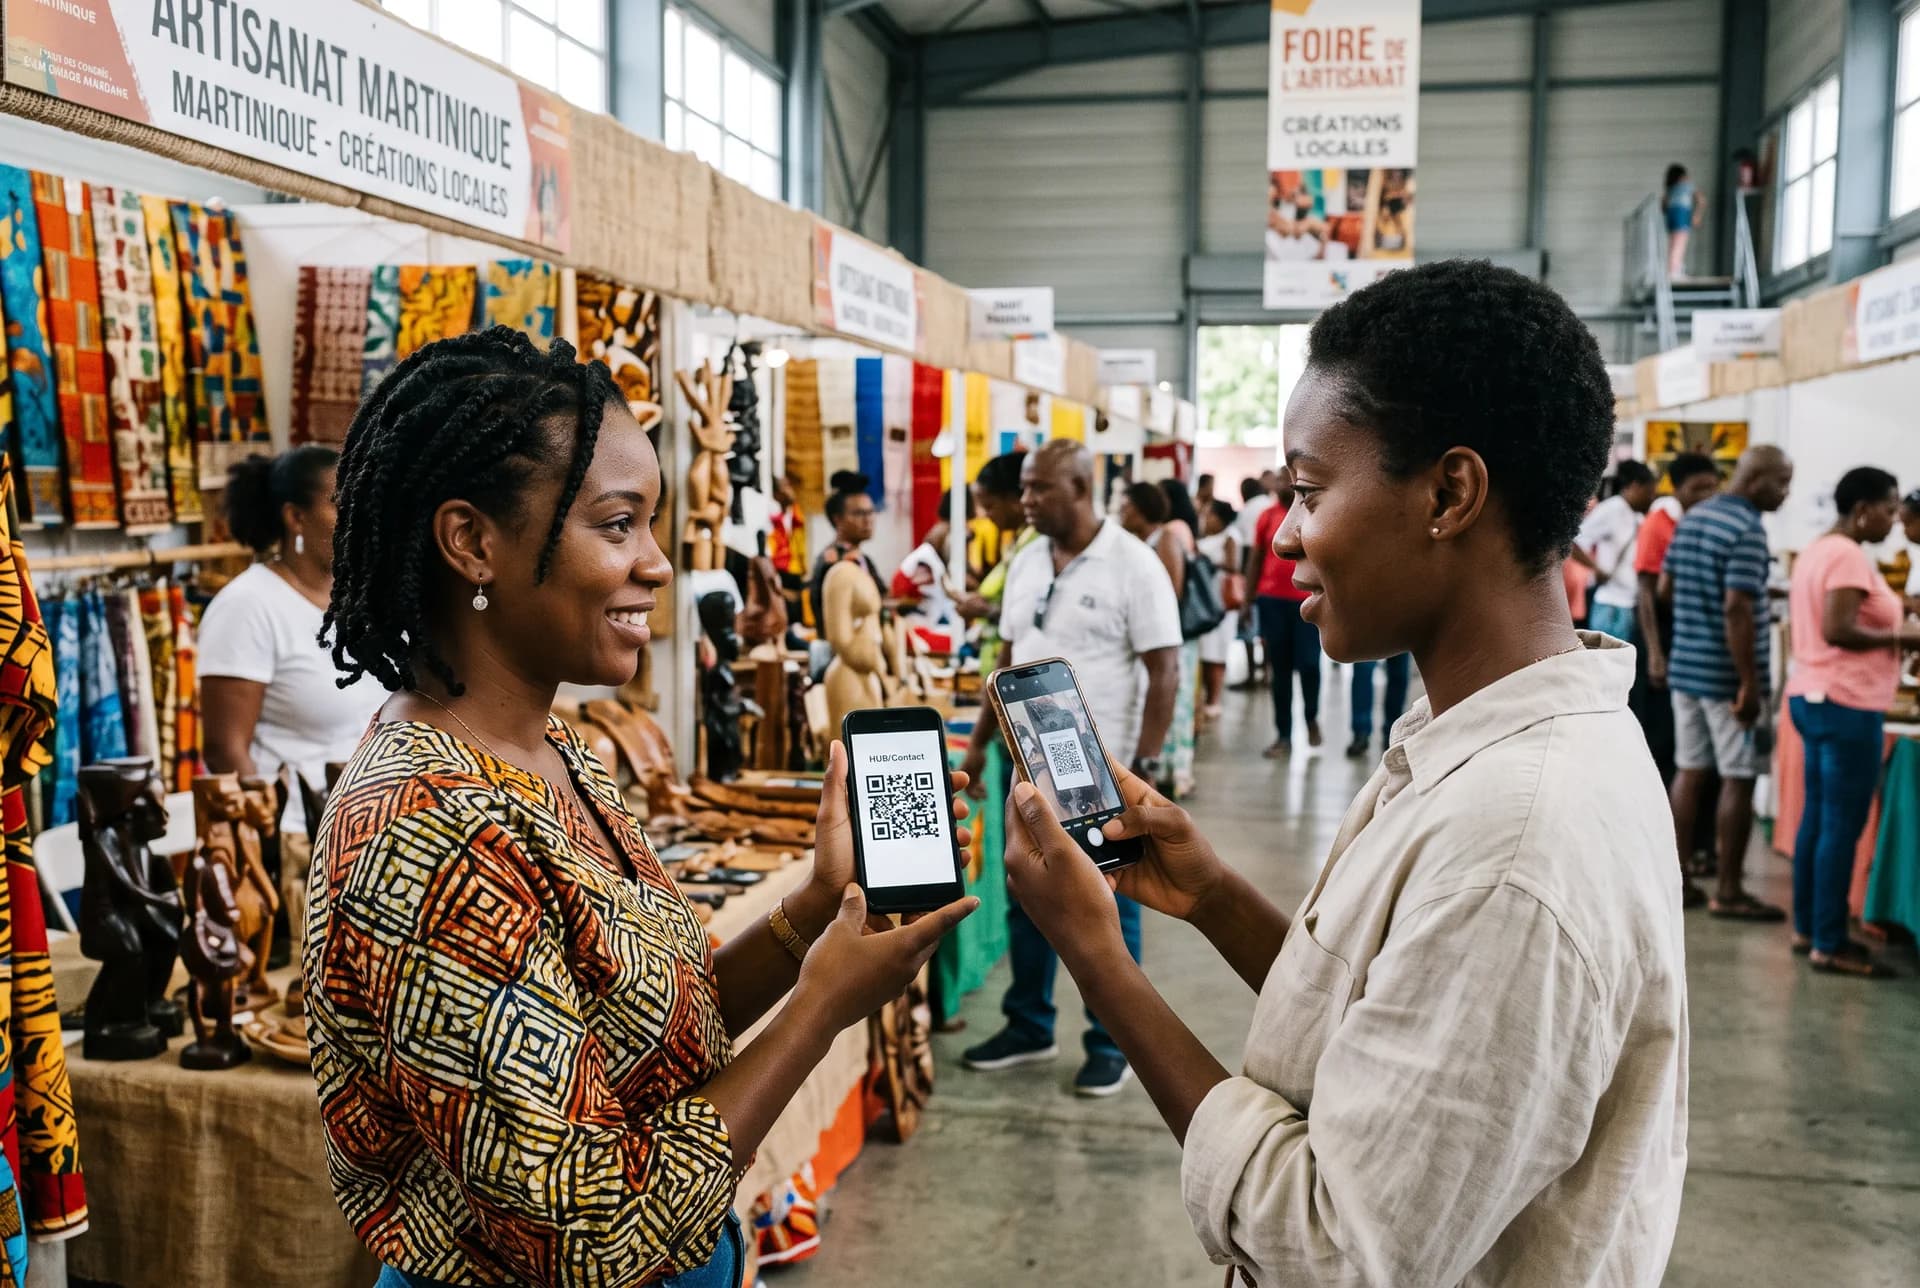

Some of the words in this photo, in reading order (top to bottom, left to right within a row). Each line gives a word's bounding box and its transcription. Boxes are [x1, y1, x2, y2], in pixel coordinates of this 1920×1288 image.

[1284, 26, 1375, 63] FOIRE
[1385, 38, 1407, 60] DE
[152, 0, 348, 106] ARTISANAT
[358, 57, 512, 170] MARTINIQUE
[1282, 65, 1406, 91] L'ARTISANAT
[1282, 113, 1403, 134] CRÉATIONS
[172, 70, 317, 157] MARTINIQUE
[339, 132, 437, 195] CRÉATIONS
[443, 166, 508, 219] LOCALES
[1295, 138, 1389, 157] LOCALES
[869, 753, 925, 763] HUB/Contact
